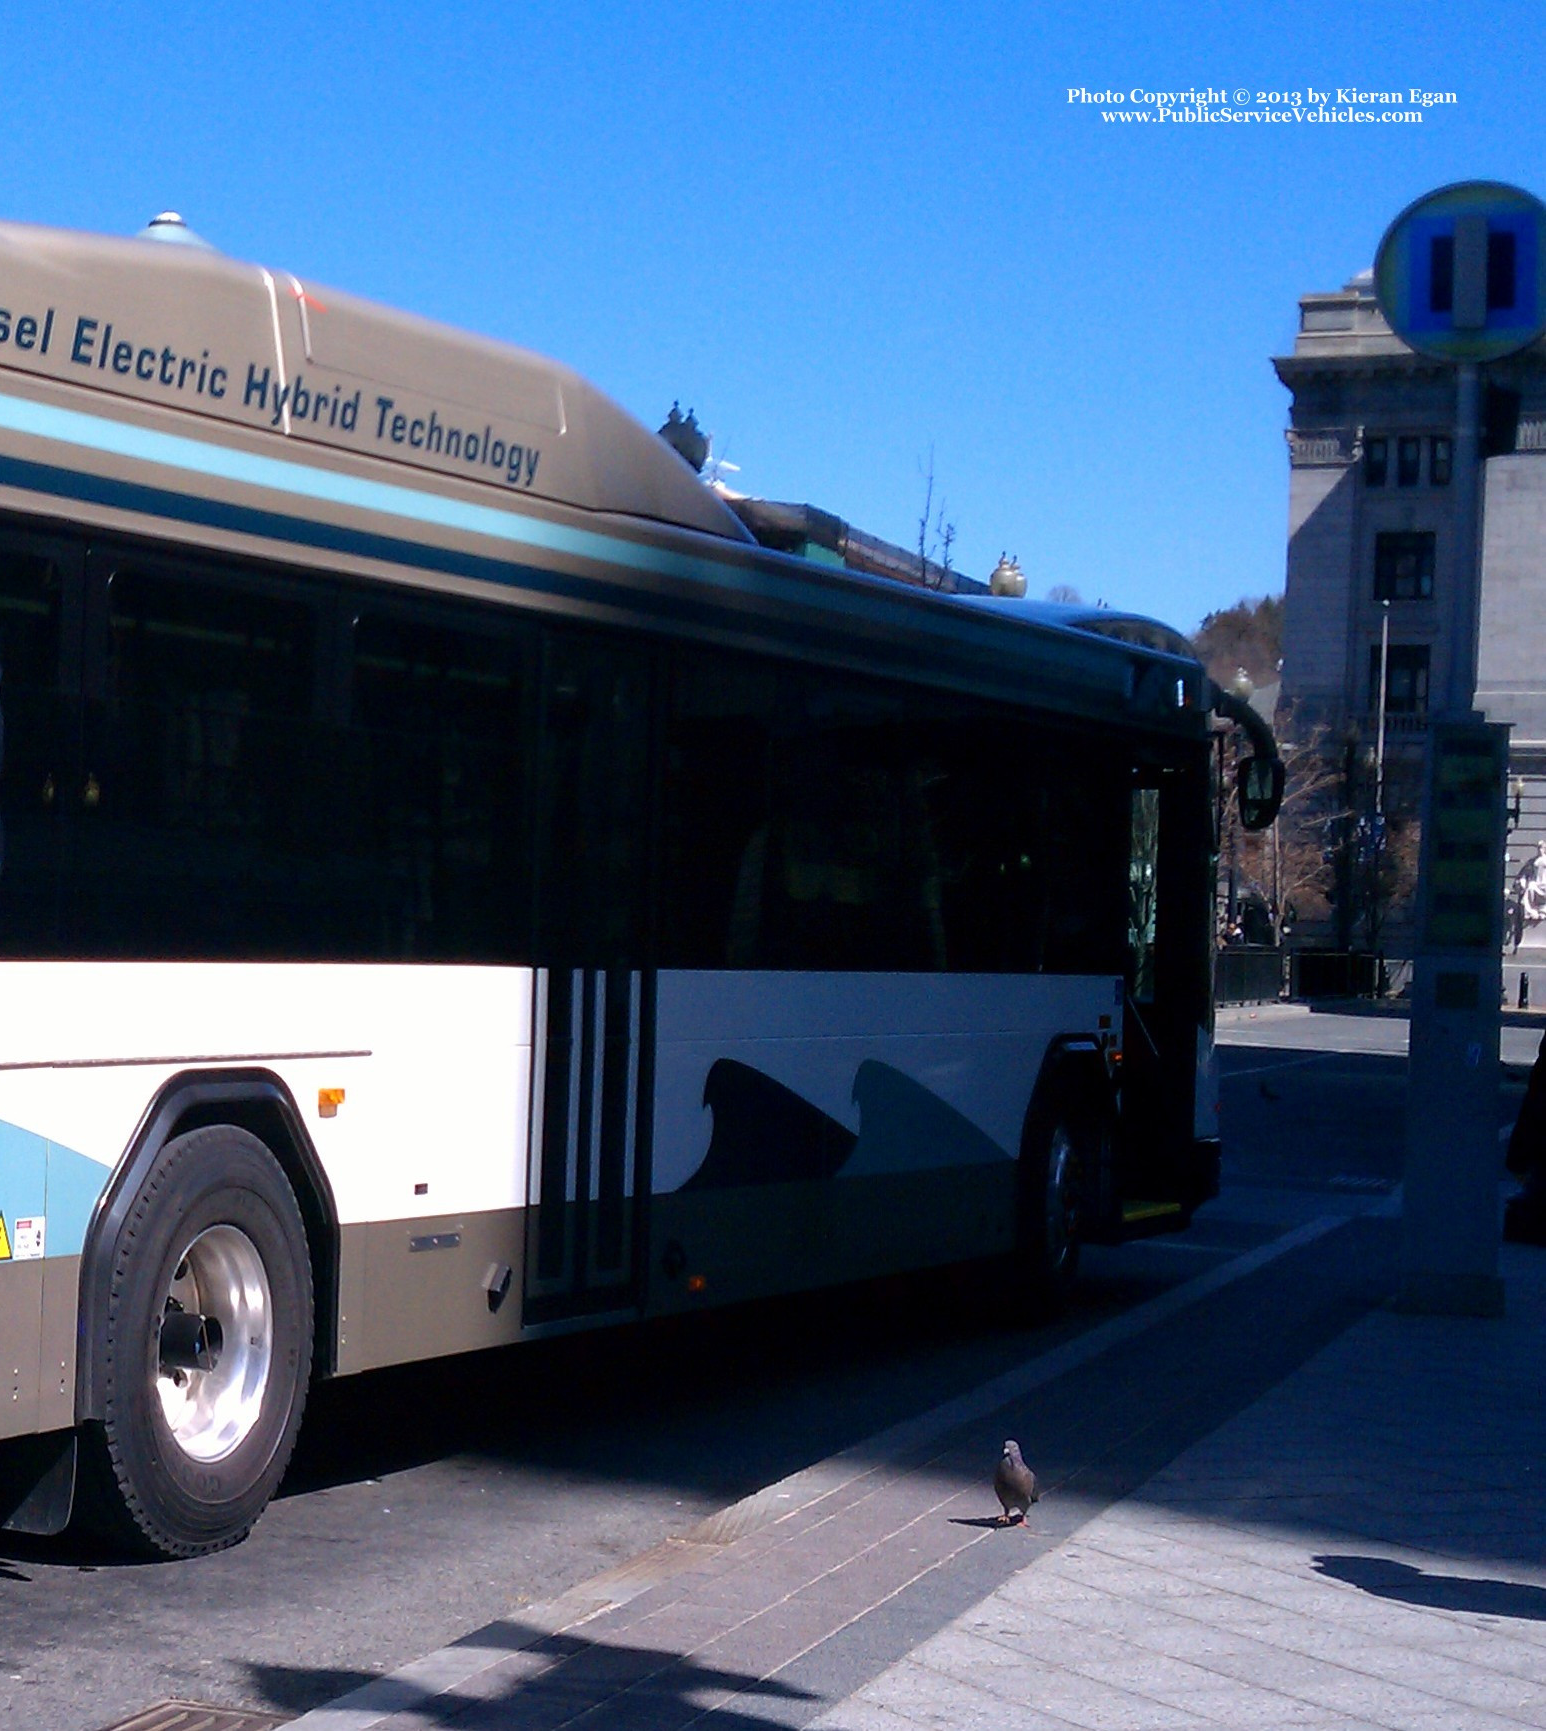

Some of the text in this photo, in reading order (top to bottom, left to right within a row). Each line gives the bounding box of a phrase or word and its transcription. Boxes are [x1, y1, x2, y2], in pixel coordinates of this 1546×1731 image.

[71, 315, 227, 398] Electric
[244, 362, 361, 432] Hybrid
[375, 396, 540, 487] Technology
